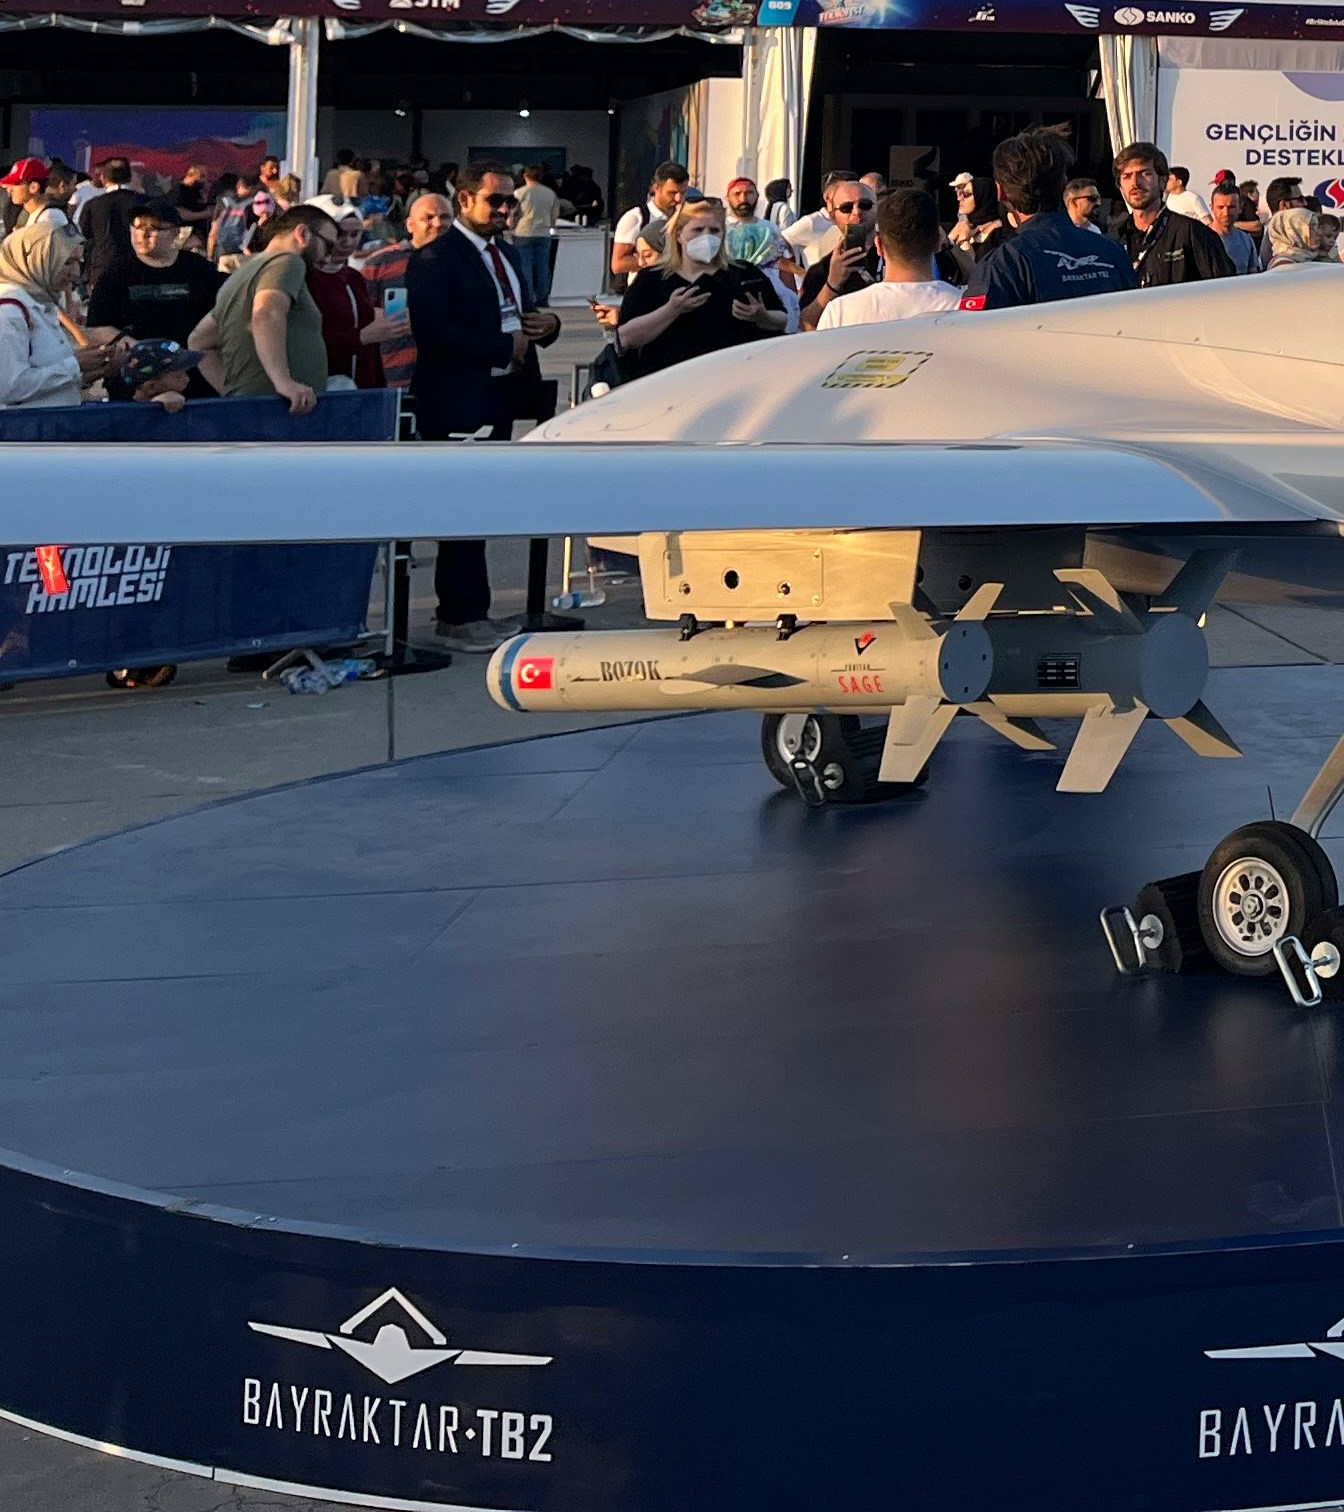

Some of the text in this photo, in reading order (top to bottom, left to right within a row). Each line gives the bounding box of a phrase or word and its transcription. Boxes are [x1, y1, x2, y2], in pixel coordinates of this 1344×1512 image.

[1146, 10, 1196, 25] SANKO
[1205, 119, 1337, 145] GENÇLİĞİN
[4, 545, 172, 585] TENOLOJİ
[600, 660, 662, 682] BOZOK
[837, 675, 886, 694] SAGE
